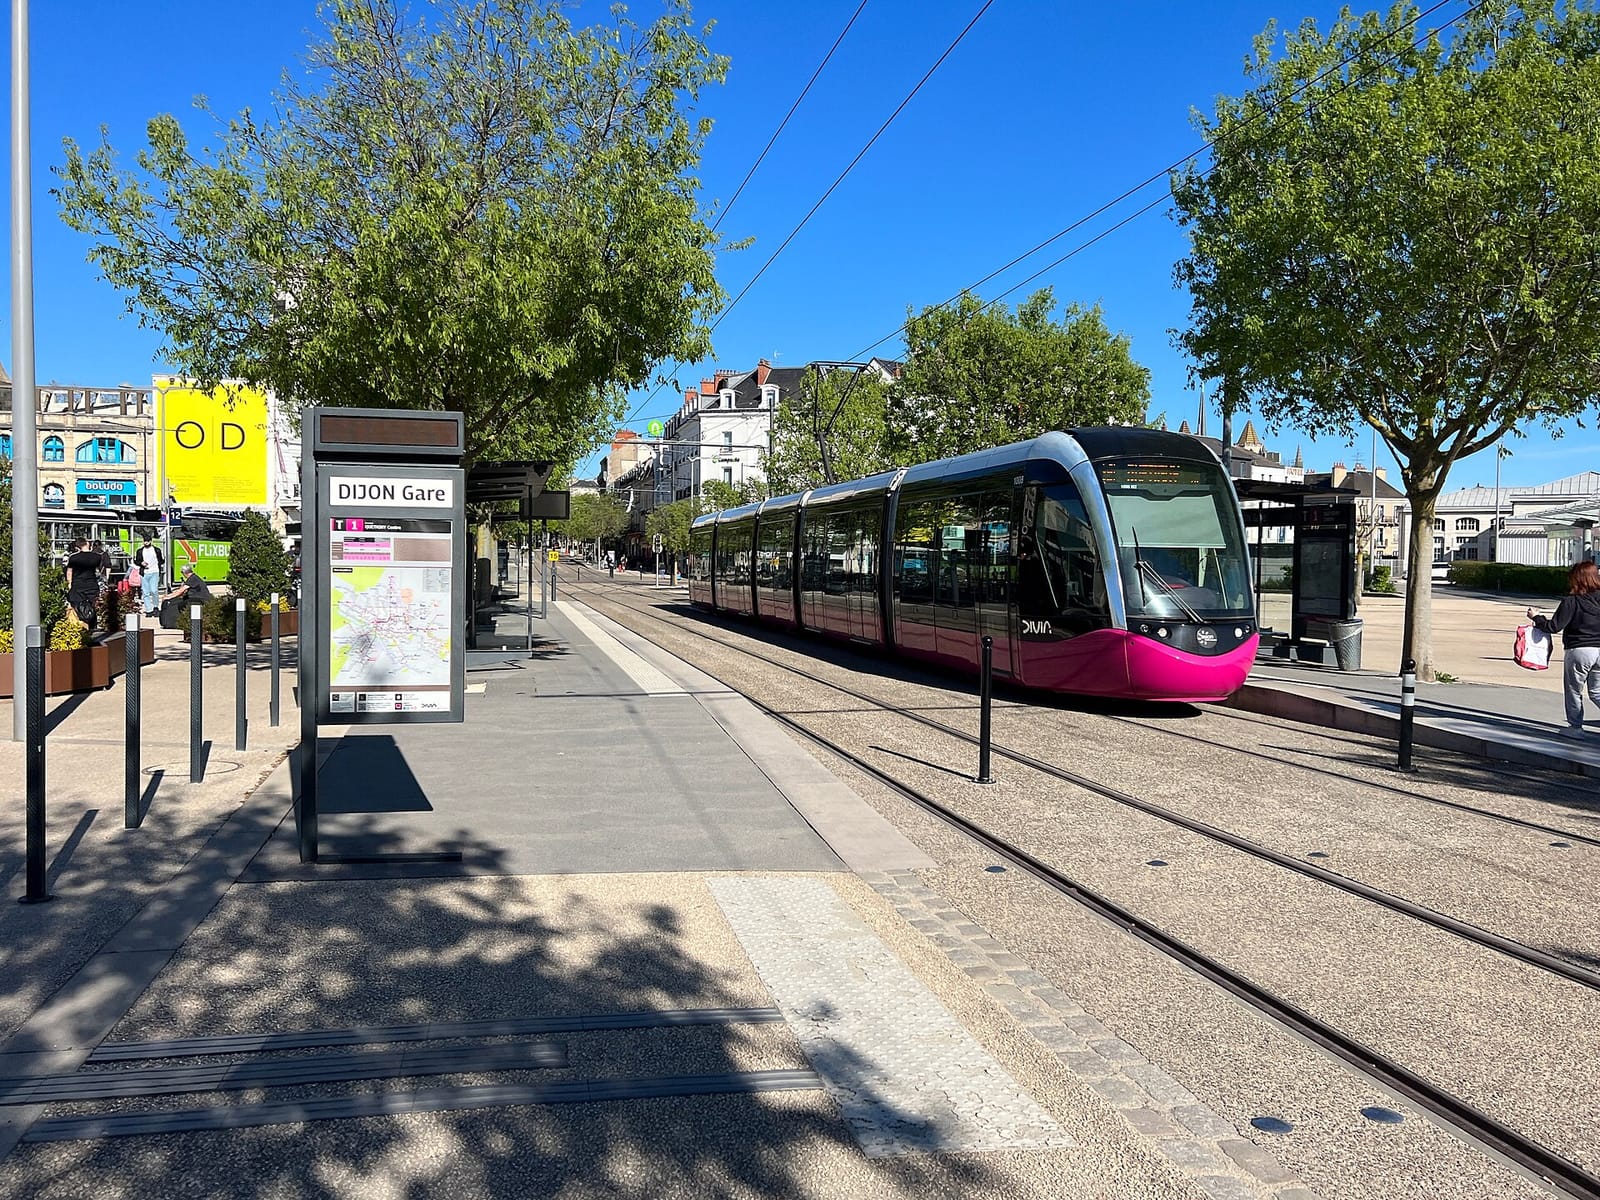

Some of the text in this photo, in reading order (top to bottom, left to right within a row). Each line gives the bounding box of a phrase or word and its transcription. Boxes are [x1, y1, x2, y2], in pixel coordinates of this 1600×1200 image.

[176, 421, 245, 450] O D
[339, 484, 445, 501] DIJON Gare
[171, 511, 181, 520] 12
[351, 521, 358, 530] 1
